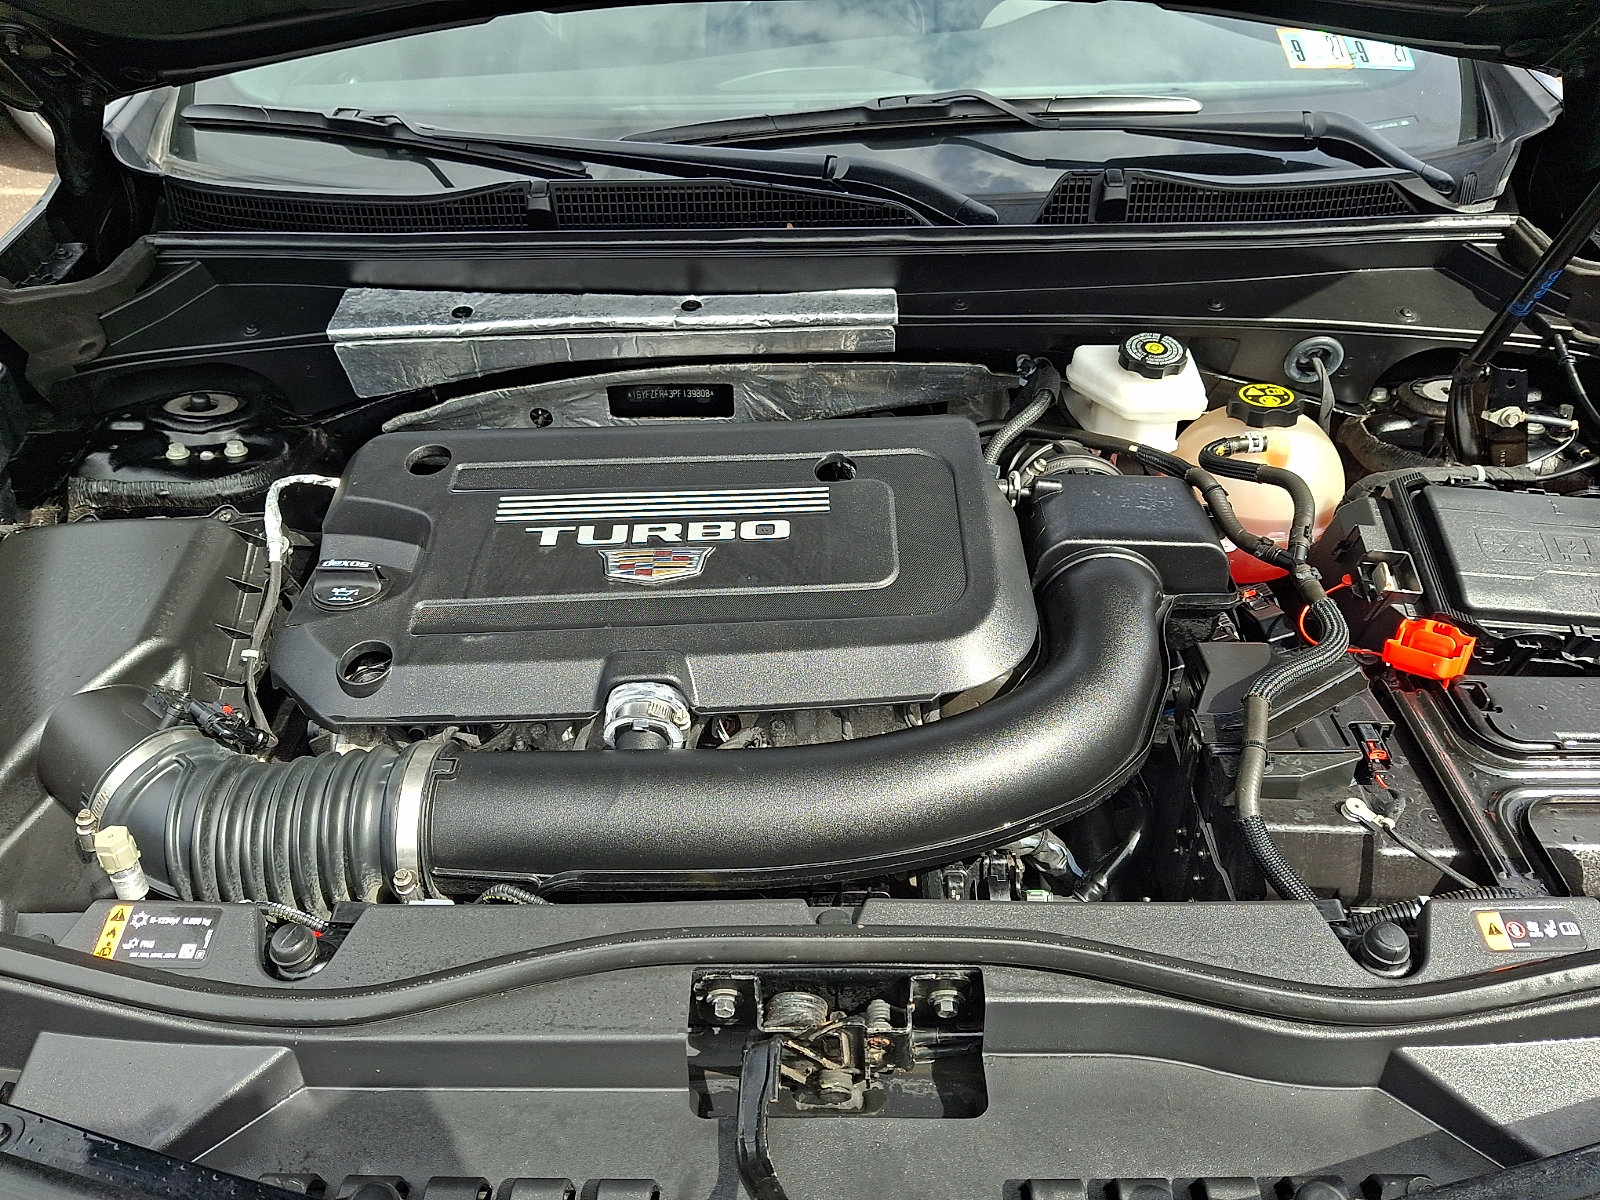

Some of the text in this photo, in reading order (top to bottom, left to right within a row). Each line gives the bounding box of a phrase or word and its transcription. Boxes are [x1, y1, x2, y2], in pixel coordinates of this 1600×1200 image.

[1291, 39, 1306, 61] 9
[1355, 40, 1370, 63] 9
[525, 520, 791, 547] TURBO
[321, 559, 373, 568] dexos
